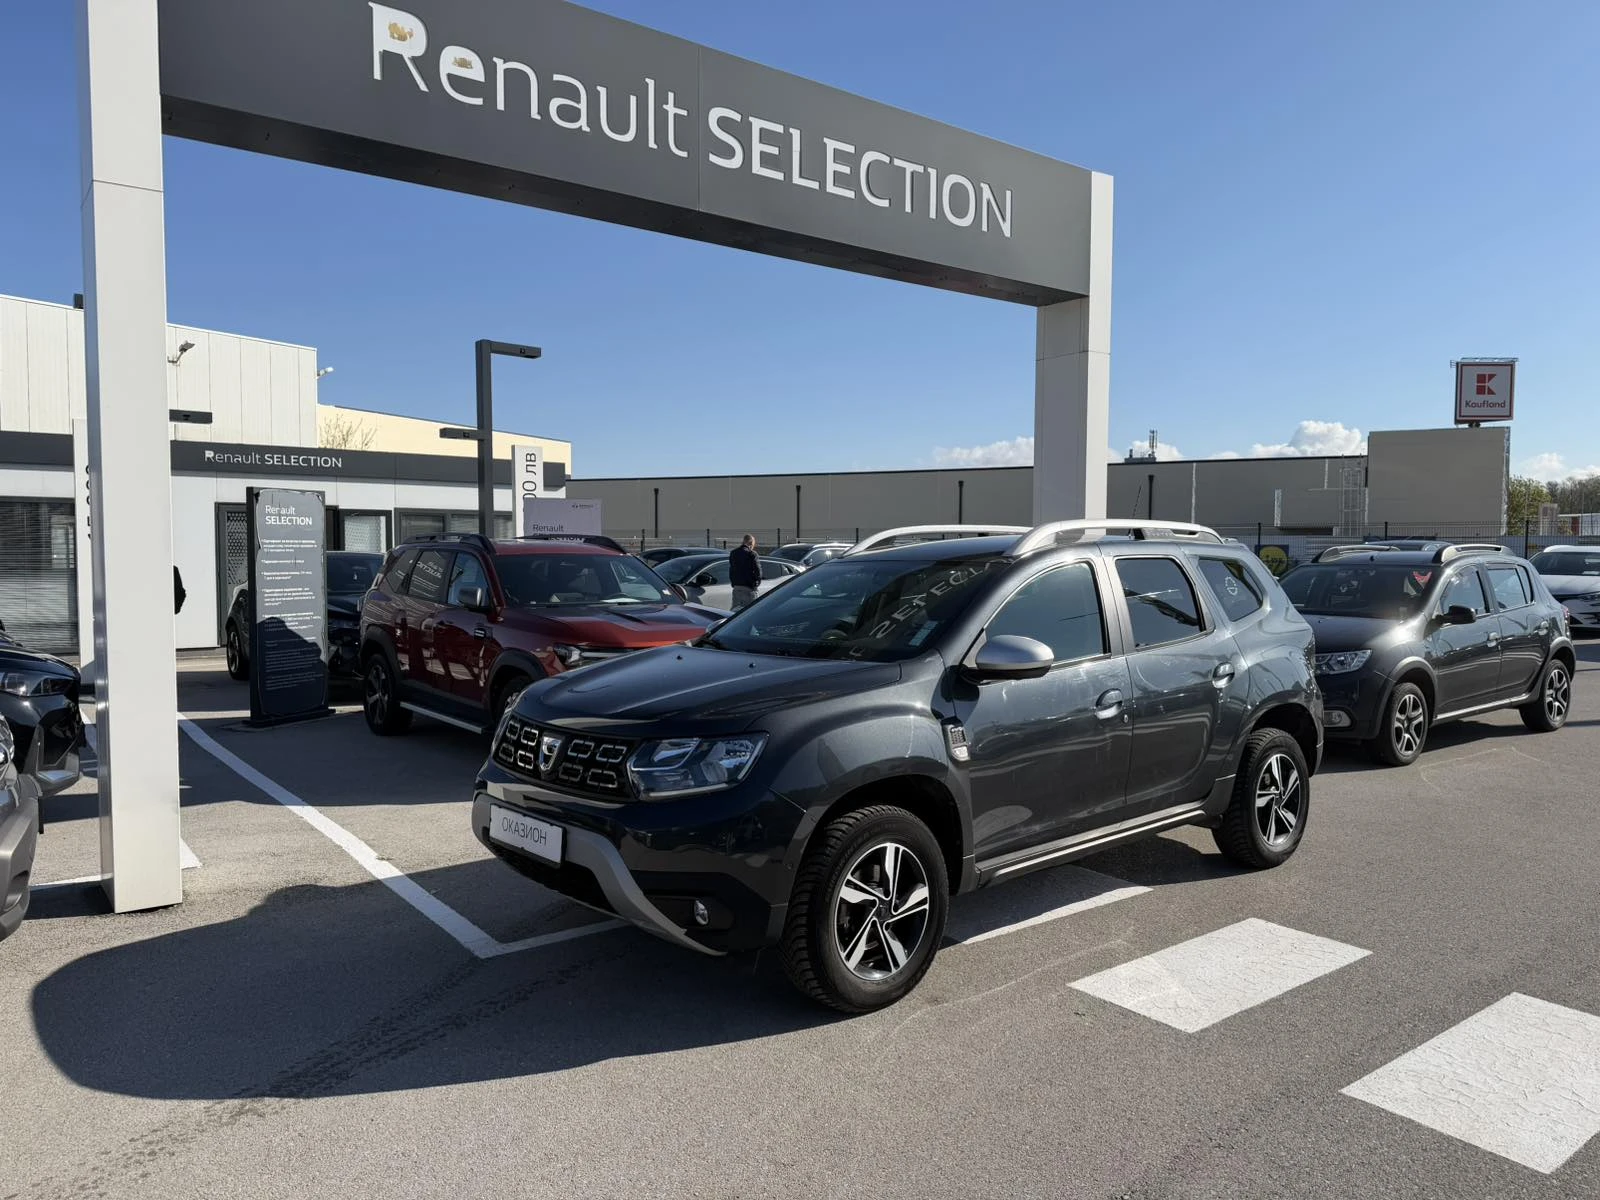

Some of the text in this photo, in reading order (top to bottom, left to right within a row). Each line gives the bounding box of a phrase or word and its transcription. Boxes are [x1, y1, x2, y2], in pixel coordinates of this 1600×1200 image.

[368, 1, 1013, 239] Renault SELECTION
[1464, 400, 1506, 408] Kaufland
[204, 450, 342, 468] Renault SELECTION
[265, 515, 313, 526] SELECTION
[532, 523, 564, 532] Renault
[501, 816, 547, 846] ОКАЗИОН
